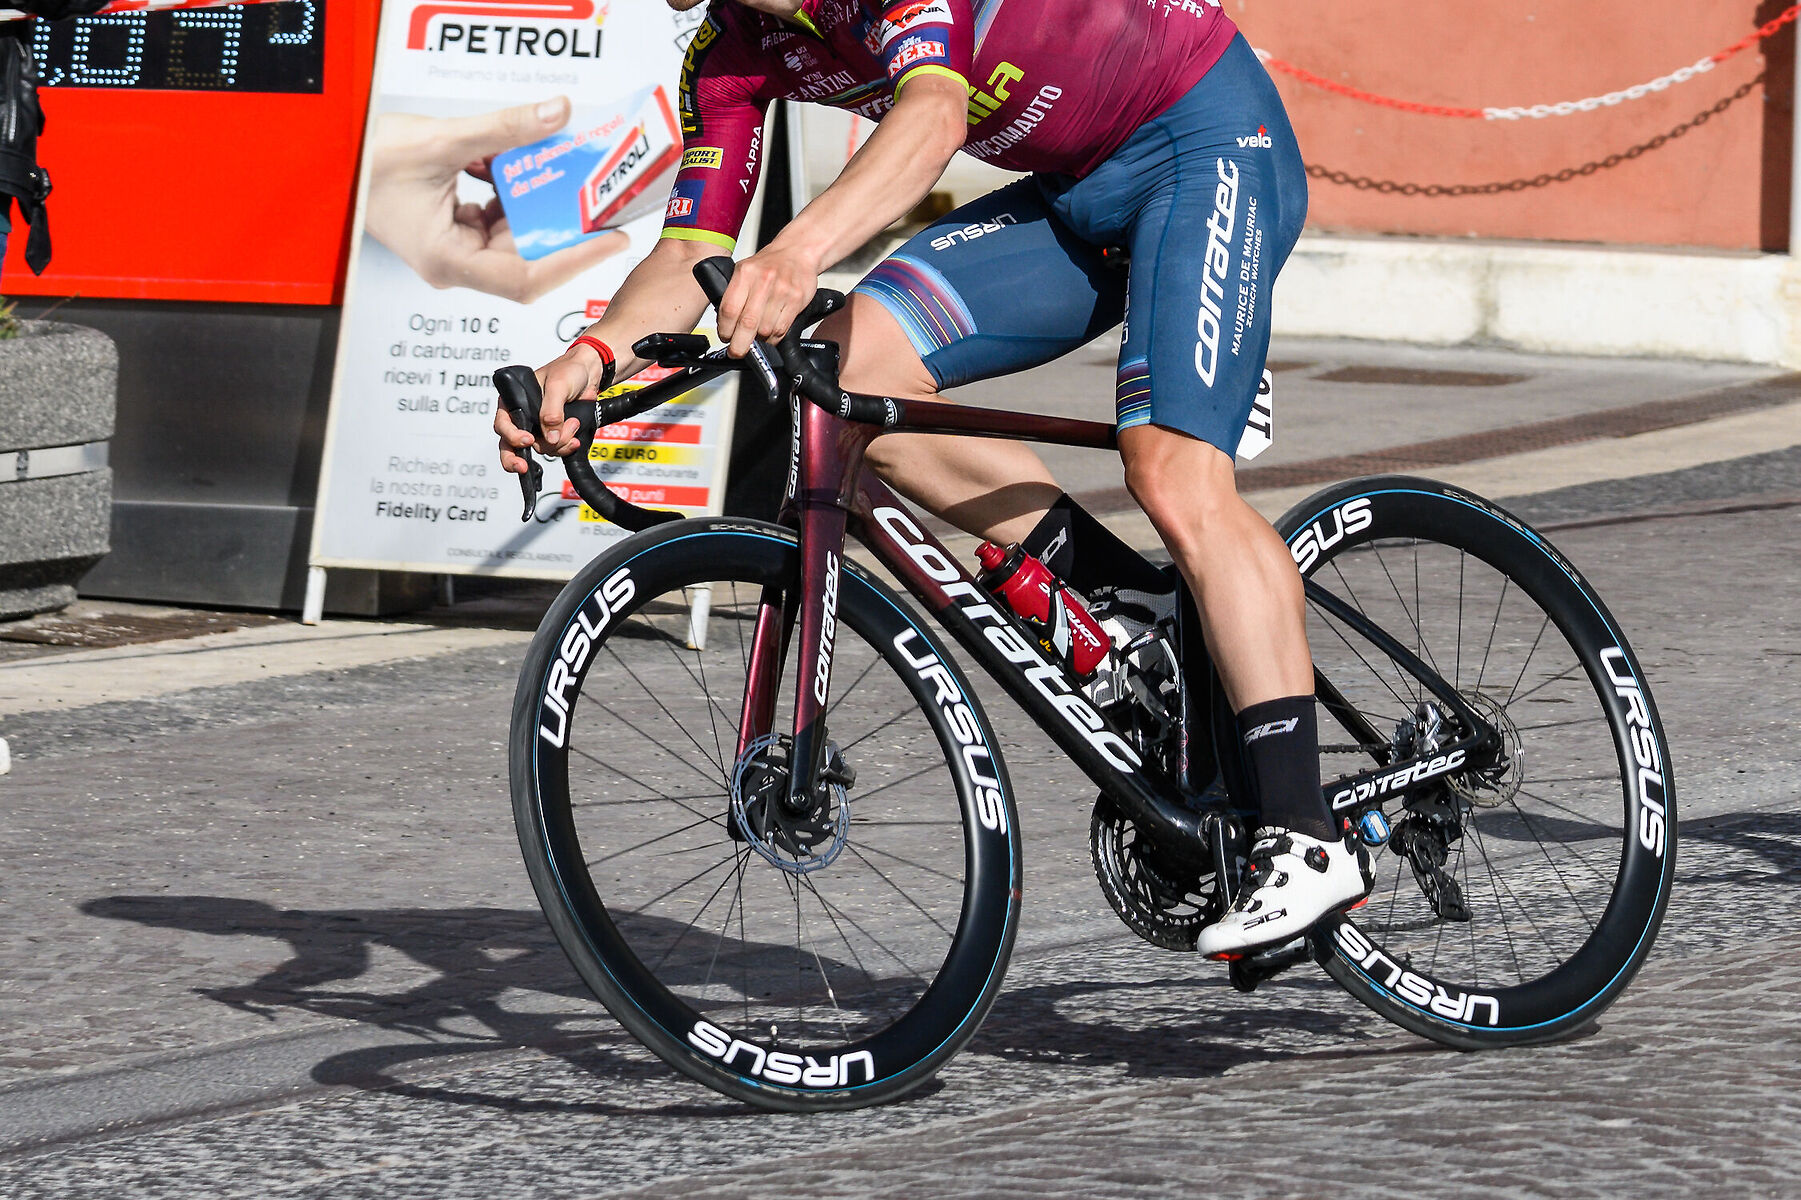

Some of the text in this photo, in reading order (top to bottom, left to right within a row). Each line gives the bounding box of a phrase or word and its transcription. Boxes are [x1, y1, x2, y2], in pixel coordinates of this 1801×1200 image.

[887, 40, 946, 81] NERI
[534, 140, 573, 170] pieno
[573, 130, 587, 148] di
[588, 113, 625, 140] regali
[746, 125, 762, 175] APRA
[1236, 130, 1272, 148] velo
[511, 180, 530, 198] da
[598, 133, 651, 202] PETROLI
[930, 212, 1017, 252] URSUS
[1194, 157, 1240, 388] corratec
[1231, 196, 1257, 356] MAURICE DE MAURIAC
[1246, 228, 1263, 329] ZURICH WATCHES
[409, 313, 453, 336] Ogni
[460, 316, 481, 333] 10
[390, 340, 511, 361] di carburante
[384, 367, 494, 391] ricevi 1 pun
[397, 395, 491, 415] sulla Card
[590, 446, 658, 461] 50 EURO
[631, 427, 665, 440] punti
[788, 394, 800, 499] corratec
[370, 477, 499, 500] la nostra nuova
[388, 455, 487, 477] Richiedi ora
[637, 465, 700, 479] Carburante
[376, 501, 489, 522] Fidelity Card
[631, 487, 666, 502] punti
[1289, 496, 1373, 574] SUS
[814, 550, 840, 706] corratec
[873, 506, 1142, 774] corratec
[539, 567, 636, 749] URSUS
[893, 627, 1007, 834] URSUS
[1599, 646, 1664, 859] URSUS
[1332, 749, 1467, 811] corratec
[1333, 922, 1500, 1026] URSUS
[687, 1020, 875, 1087] URSUS
